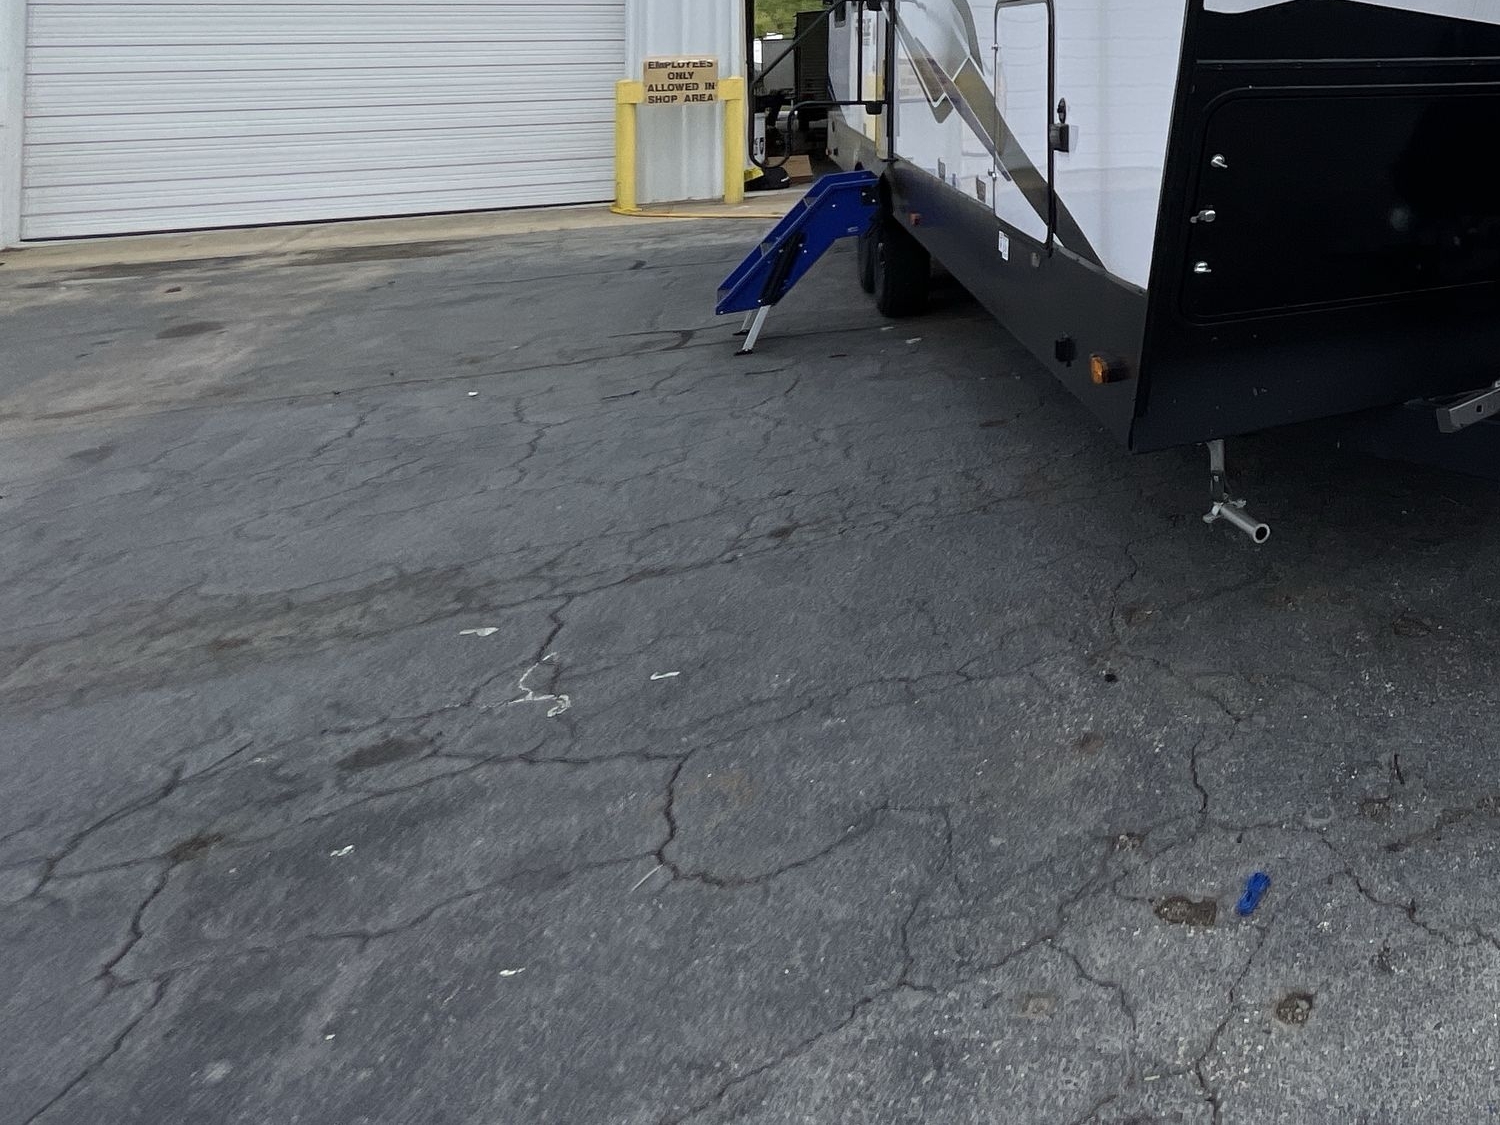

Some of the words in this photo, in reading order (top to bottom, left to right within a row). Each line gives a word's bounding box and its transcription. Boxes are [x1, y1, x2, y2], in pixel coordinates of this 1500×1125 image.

[648, 61, 713, 69] EMPLOYEES
[667, 71, 694, 80] ONLY
[647, 82, 699, 92] ALLOWED
[704, 82, 715, 90] IN
[648, 95, 678, 104] SHOP
[684, 93, 713, 102] AREA
